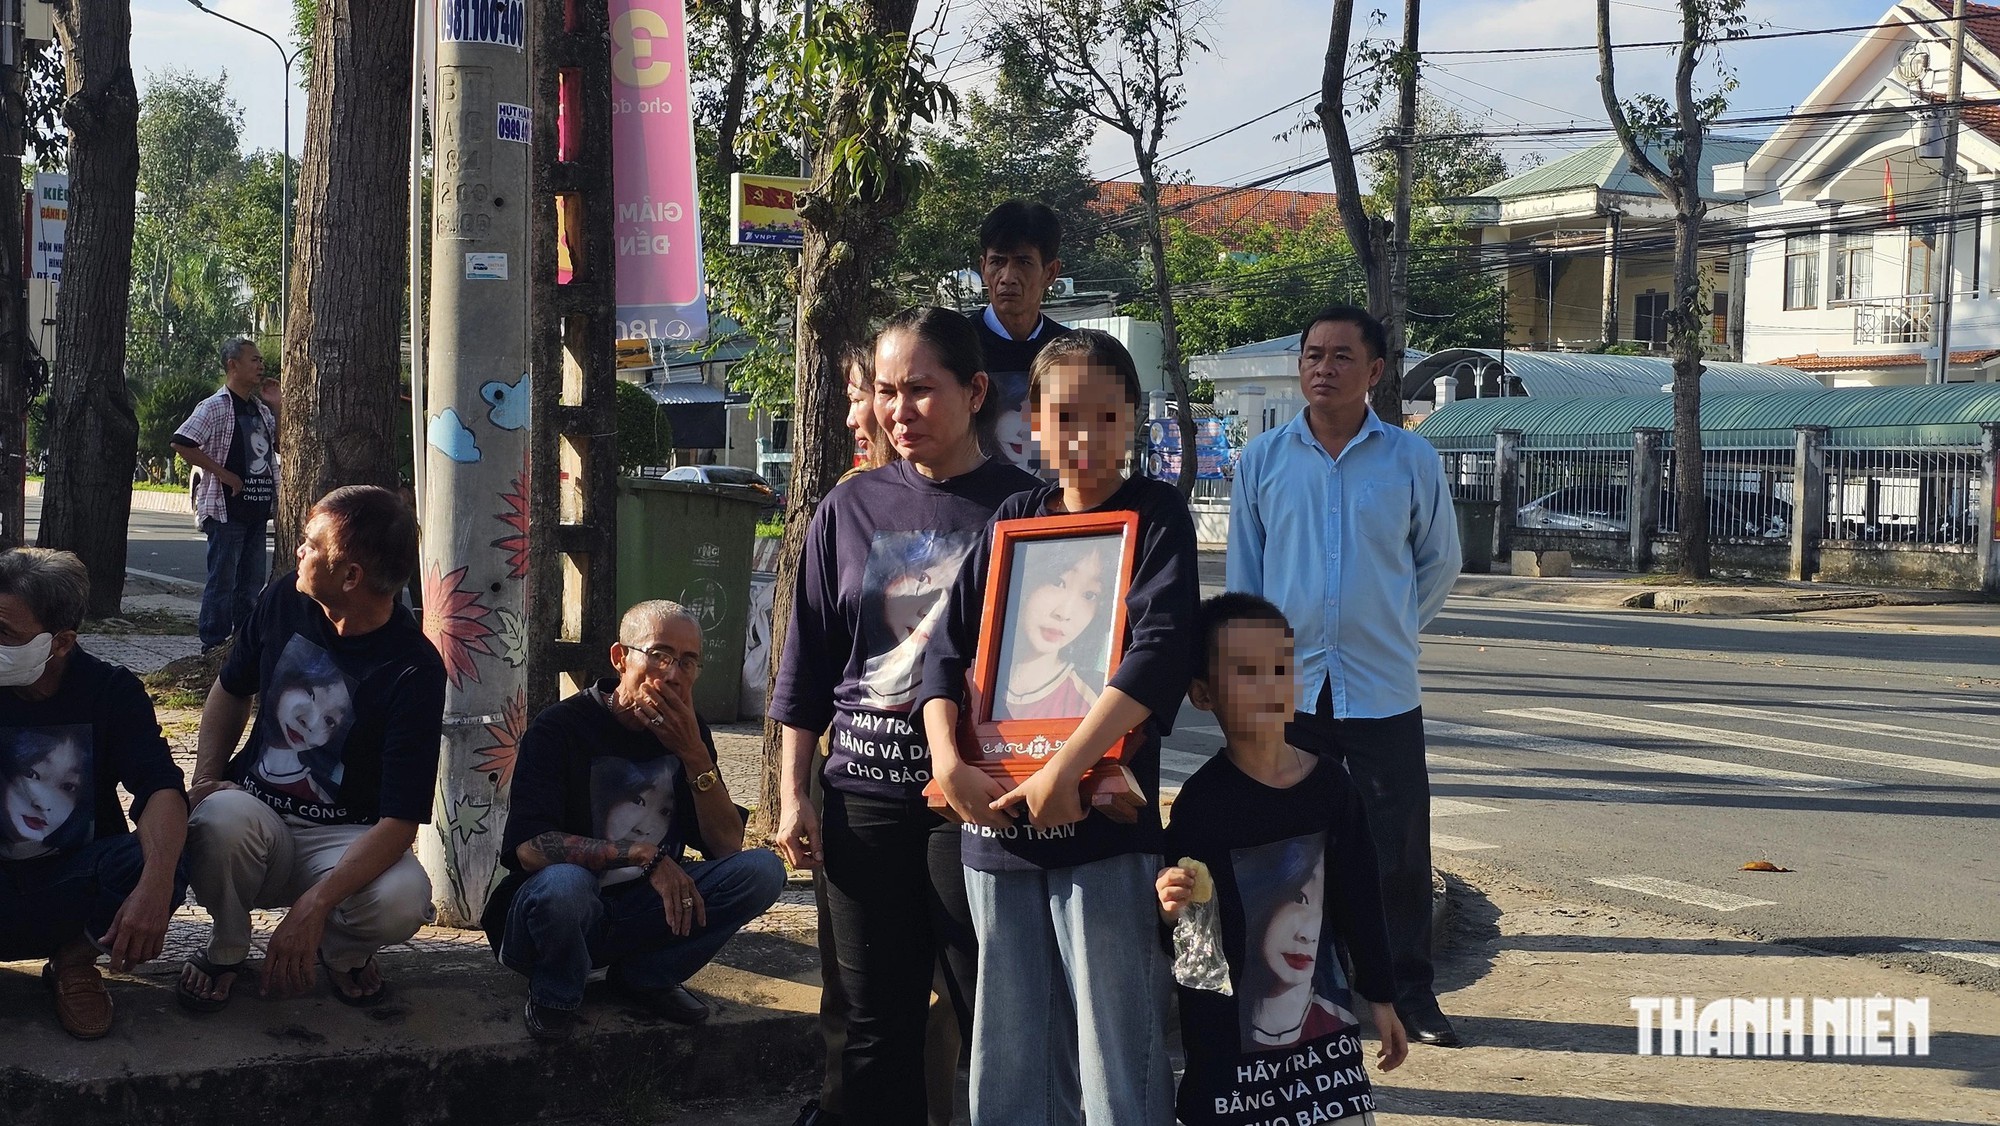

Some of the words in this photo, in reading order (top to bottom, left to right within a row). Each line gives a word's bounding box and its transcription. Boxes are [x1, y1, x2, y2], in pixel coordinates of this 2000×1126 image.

[754, 233, 777, 241] VNPT
[851, 711, 883, 731] HÃY
[879, 741, 904, 760] VÀ
[909, 744, 932, 760] DA
[847, 761, 884, 780] CHO
[888, 766, 930, 783] BẢO
[265, 794, 293, 811] TRẢ
[298, 804, 348, 819] CÔNG
[1237, 1060, 1281, 1083] HÃY
[1326, 1034, 1362, 1060] CÔN
[1215, 1090, 1276, 1115] BẰNG
[1279, 1079, 1312, 1102] VÀ
[1295, 1101, 1343, 1126] BẢO
[1348, 1089, 1376, 1113] TR
